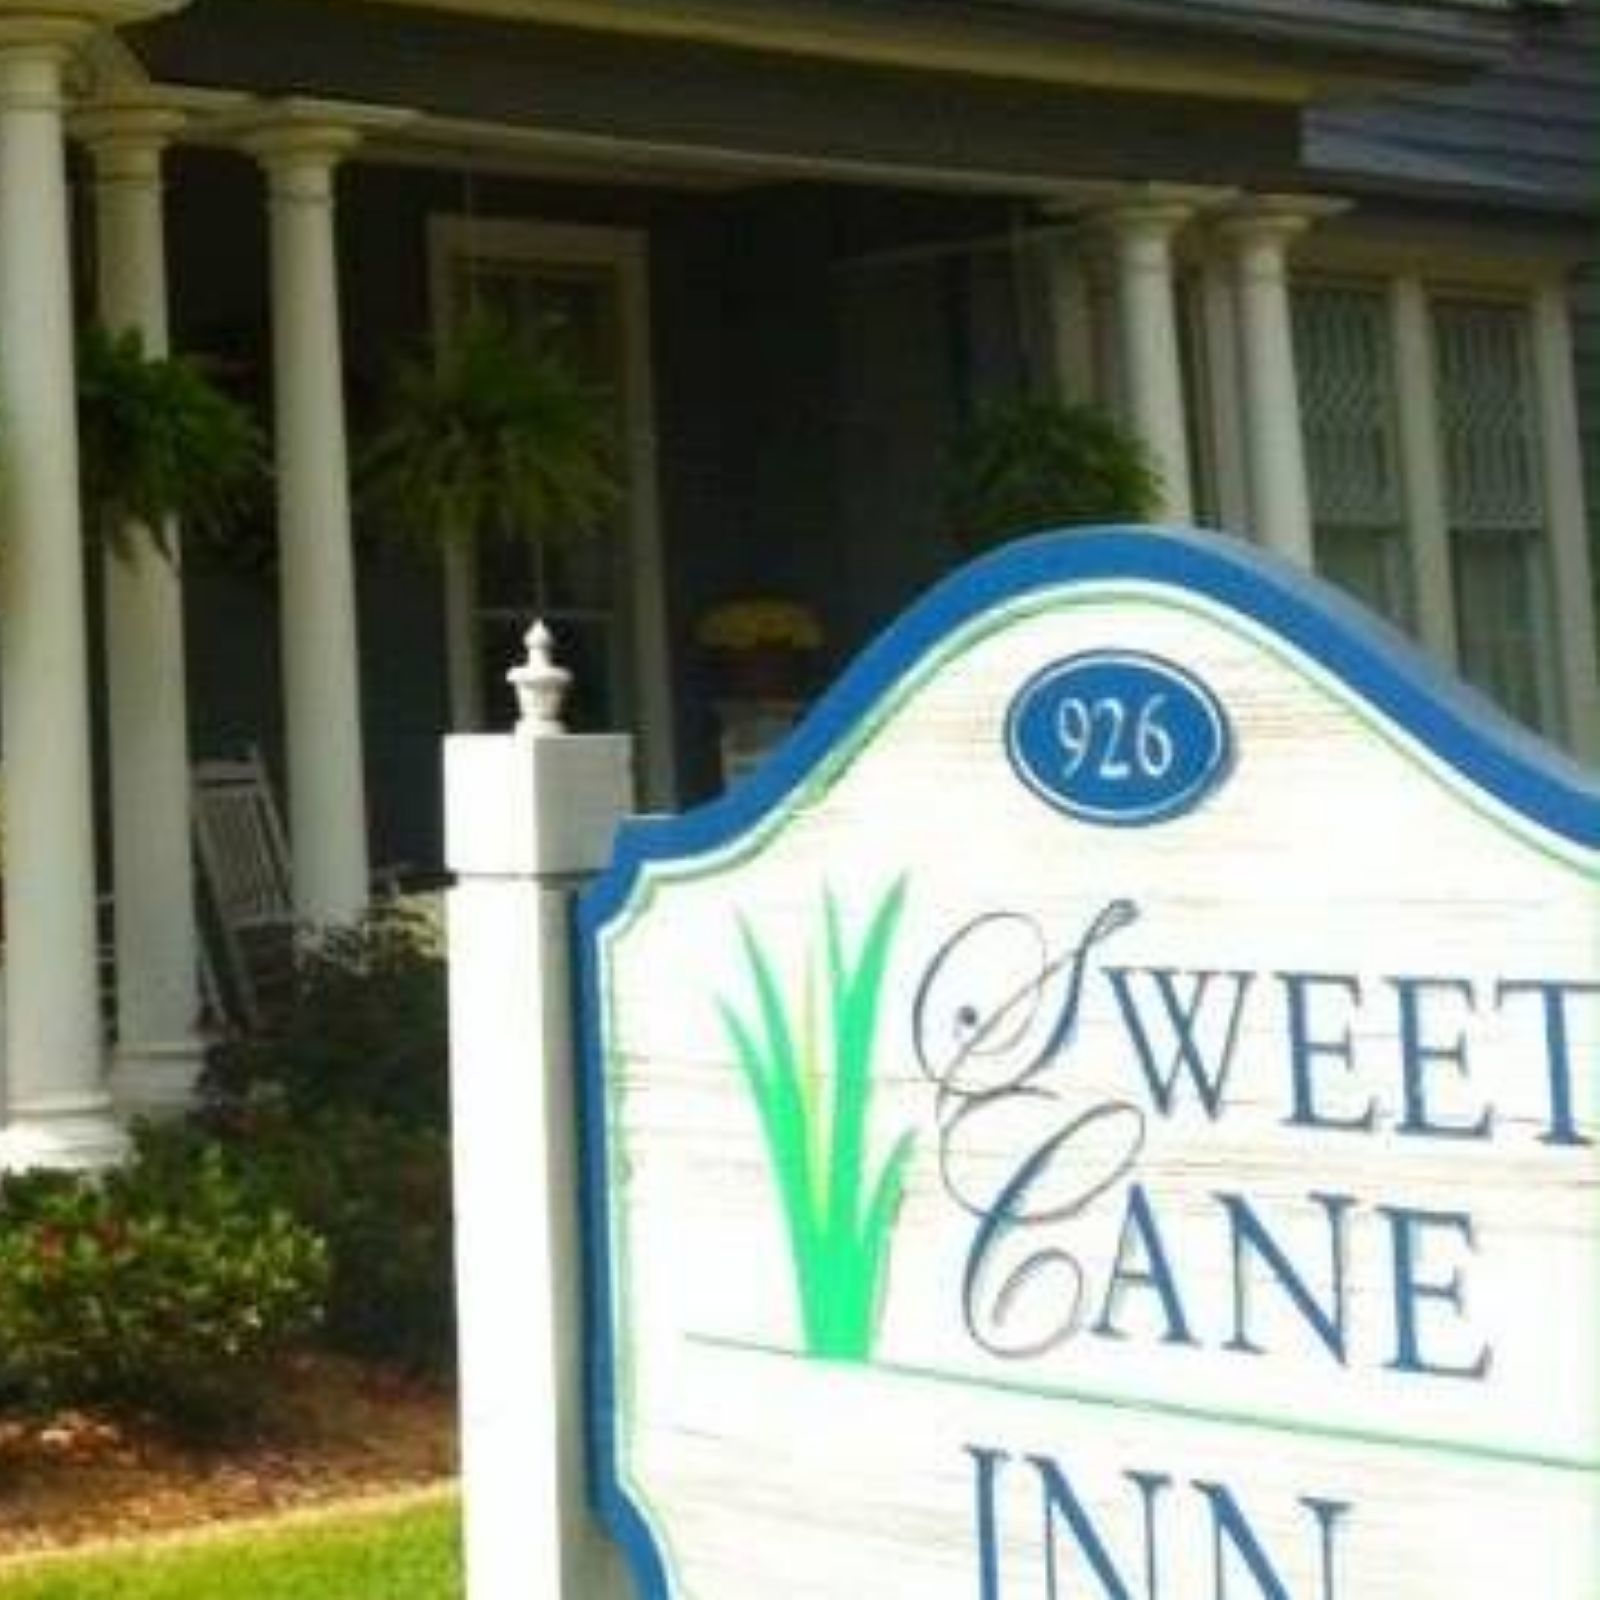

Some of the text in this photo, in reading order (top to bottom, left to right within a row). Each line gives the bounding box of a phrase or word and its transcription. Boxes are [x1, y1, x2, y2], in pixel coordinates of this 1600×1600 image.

[1058, 693, 1173, 780] 926
[912, 898, 1600, 1147] SWEET
[940, 1092, 1493, 1380] CANE
